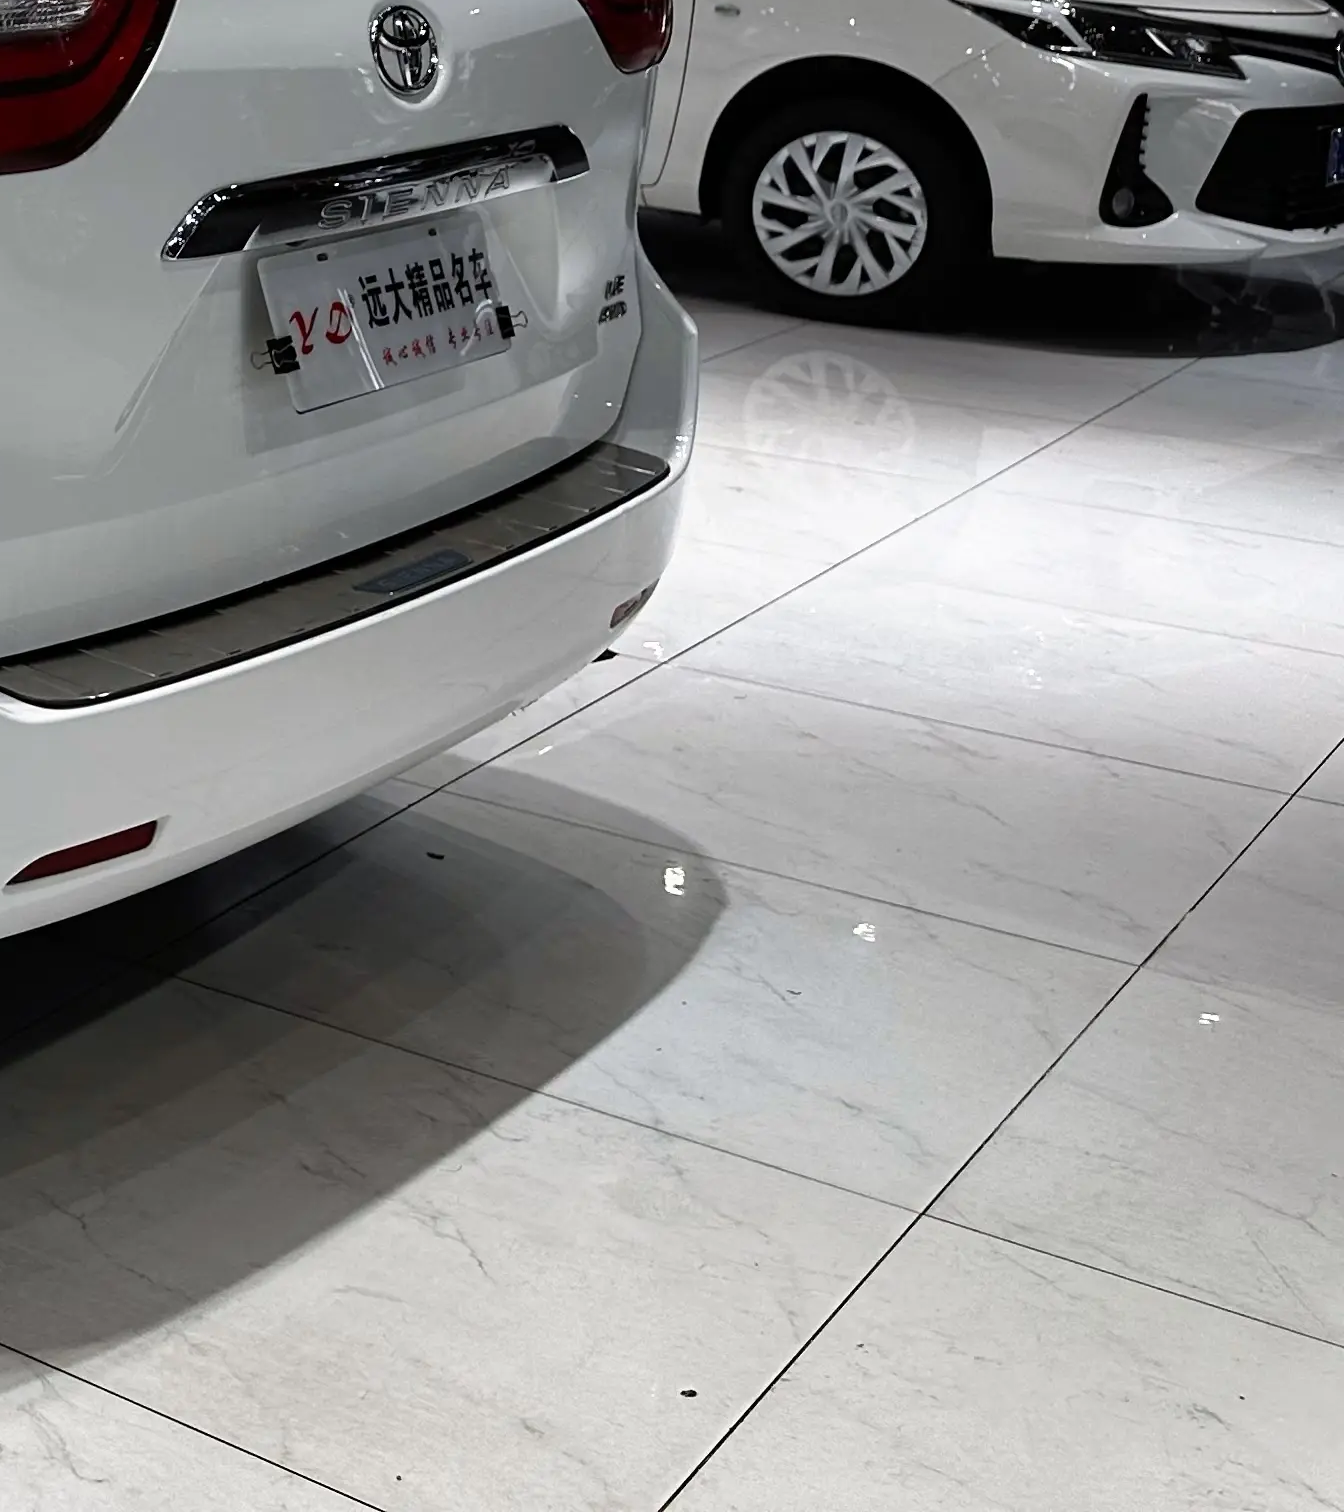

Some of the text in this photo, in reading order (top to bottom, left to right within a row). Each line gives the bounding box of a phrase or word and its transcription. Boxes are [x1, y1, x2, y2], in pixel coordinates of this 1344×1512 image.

[317, 163, 511, 230] SIENNA
[358, 247, 493, 329] 远大精品名车
